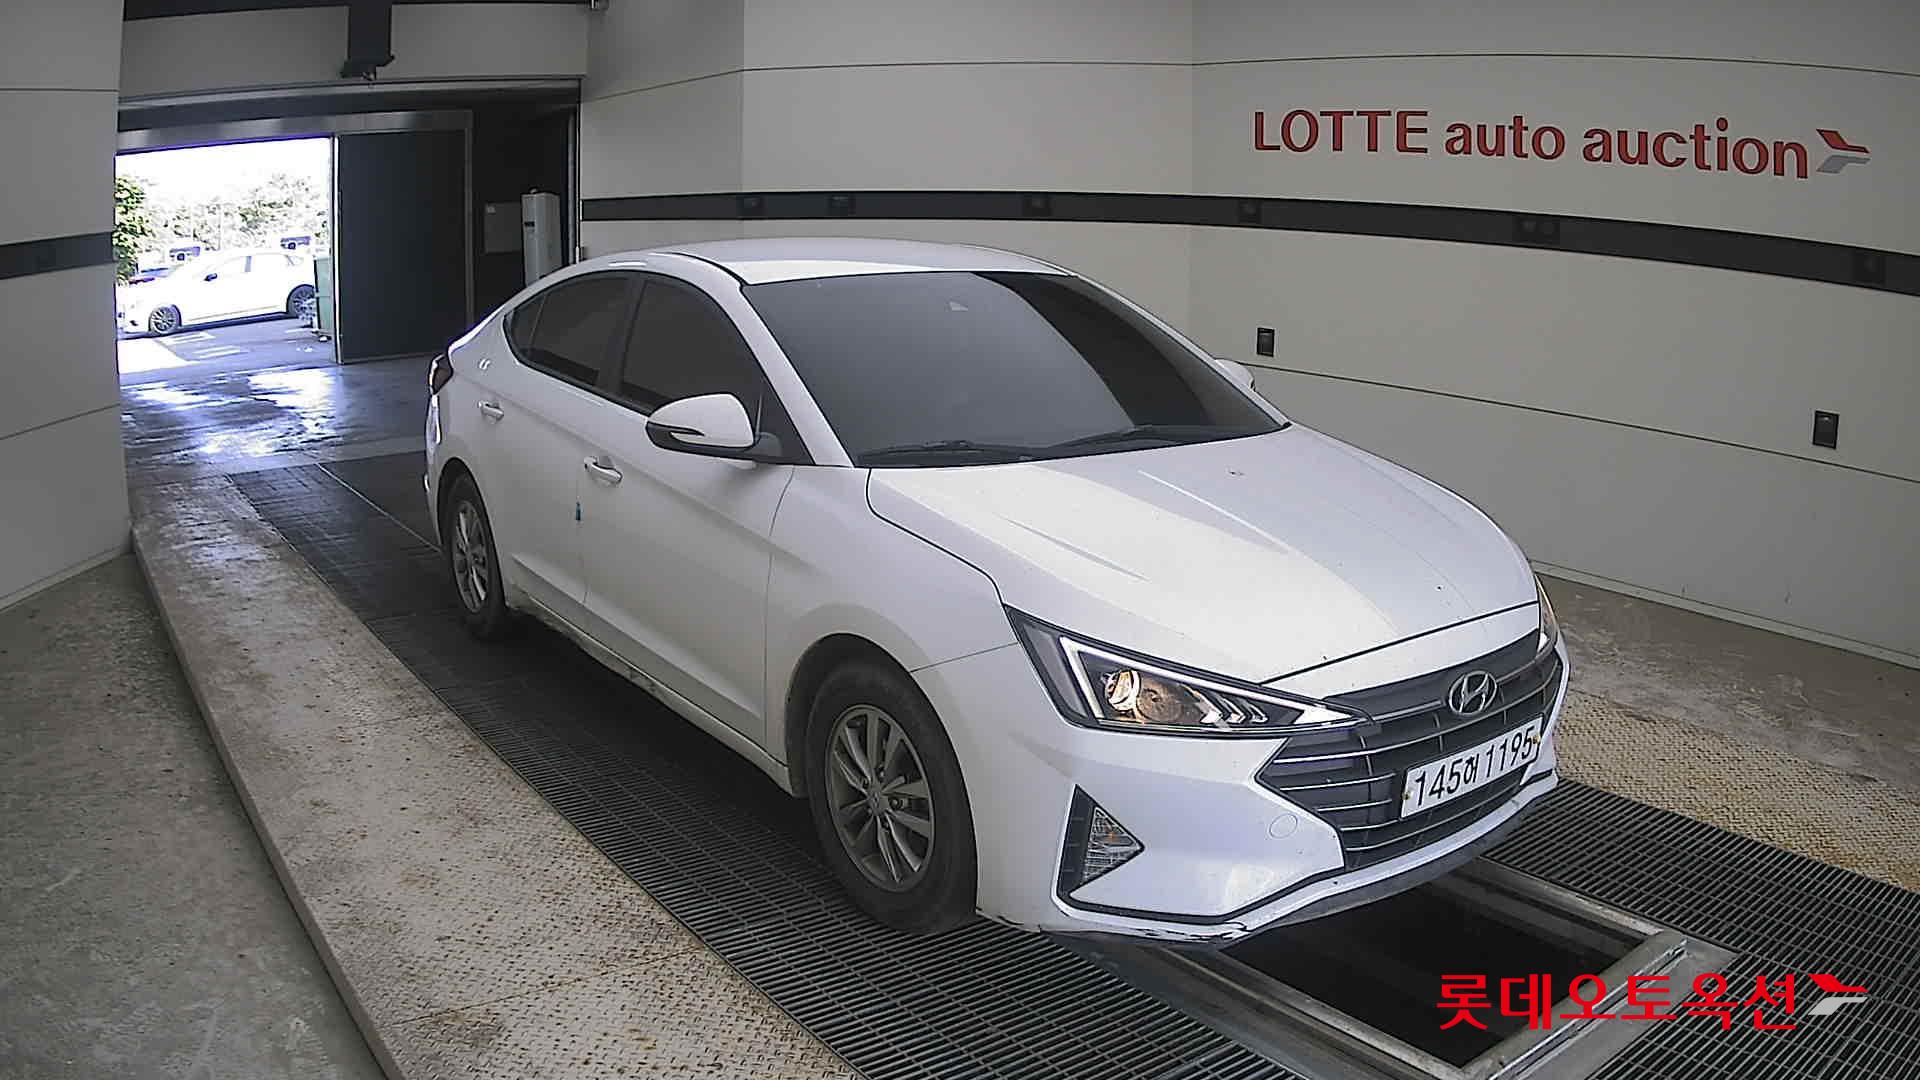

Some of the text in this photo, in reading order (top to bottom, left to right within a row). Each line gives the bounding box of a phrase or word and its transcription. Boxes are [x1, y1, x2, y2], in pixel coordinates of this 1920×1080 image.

[1253, 110, 1809, 179] LOTTE auto auction
[1415, 725, 1536, 807] 145허 1195
